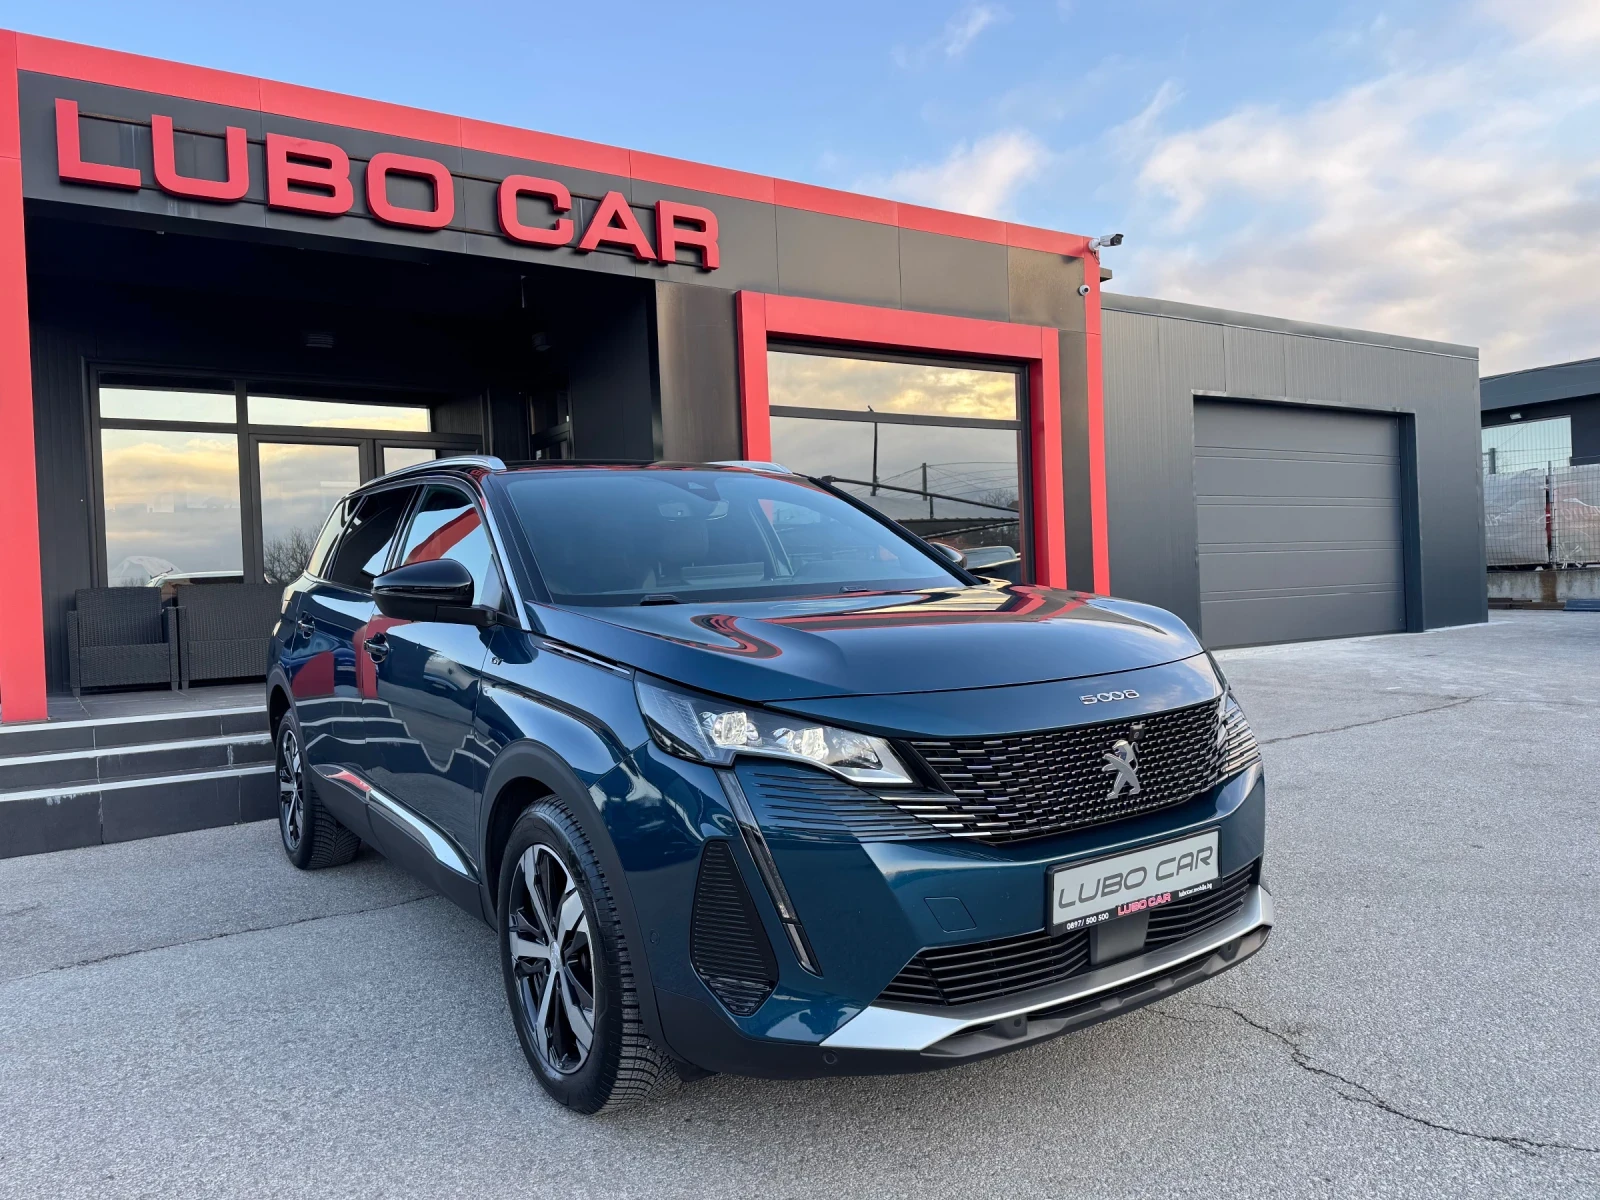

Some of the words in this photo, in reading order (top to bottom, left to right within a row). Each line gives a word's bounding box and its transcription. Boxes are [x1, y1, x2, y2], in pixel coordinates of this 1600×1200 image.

[55, 98, 456, 231] LUBO
[496, 173, 721, 271] CAR
[1080, 689, 1140, 705] 5008
[1058, 866, 1148, 909] LUBO
[1155, 846, 1214, 881] CAR
[1117, 899, 1147, 916] LUBO
[1148, 892, 1172, 907] CAR
[1085, 915, 1097, 925] 500
[1098, 912, 1110, 922] 500
